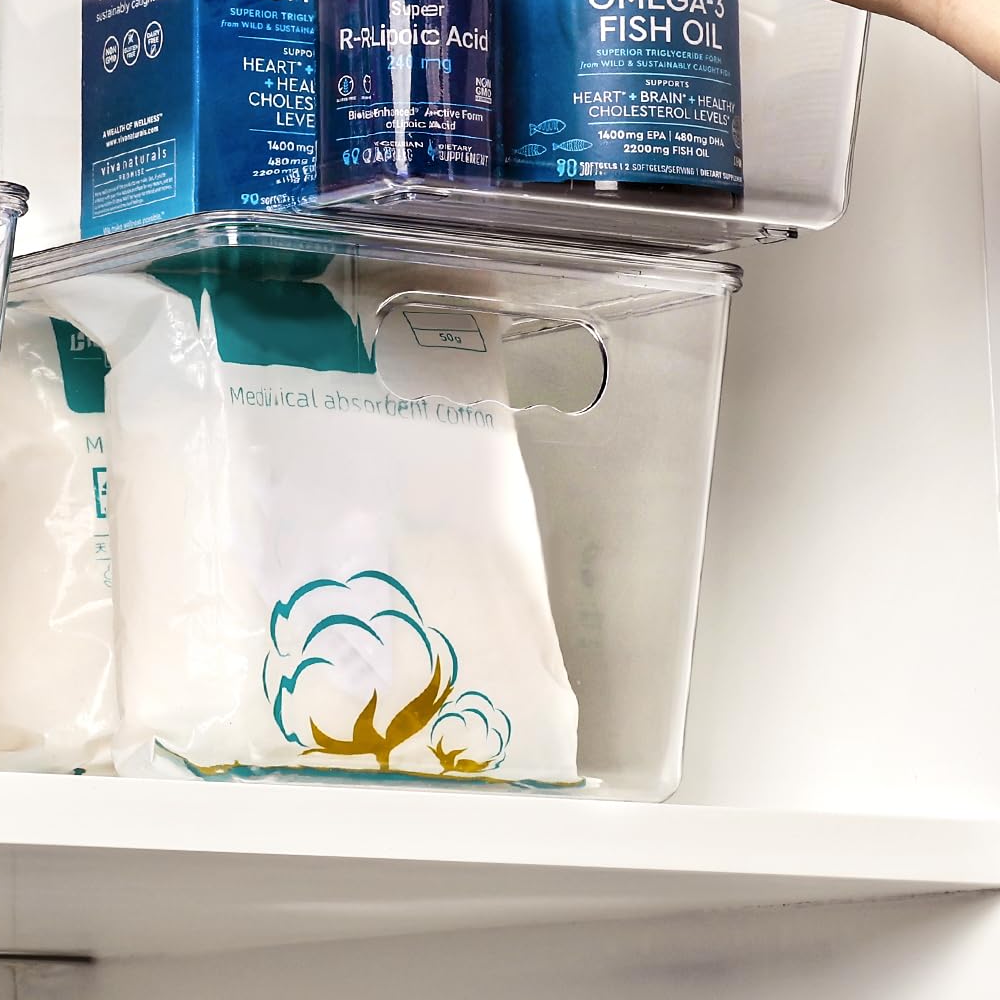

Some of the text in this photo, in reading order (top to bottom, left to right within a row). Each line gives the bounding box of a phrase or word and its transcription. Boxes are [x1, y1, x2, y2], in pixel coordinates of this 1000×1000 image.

[96, 0, 130, 23] sustainably
[230, 8, 278, 20] SUPERIOR
[220, 20, 239, 28] from
[242, 21, 264, 30] WILD
[446, 24, 489, 51] Acid
[600, 16, 722, 50] FISH OIL
[596, 48, 722, 64] SUPERIOR TRIGLYCERIDE FORM
[580, 60, 598, 70] from
[600, 60, 624, 68] WILD
[636, 60, 691, 70] SUSTAINABLY
[692, 64, 718, 75] CAUGHT
[476, 77, 492, 88] NON
[646, 79, 690, 88] SUPPORTS
[249, 92, 314, 110] CHOLES
[698, 95, 736, 113] HEALTHY
[276, 112, 315, 128] LEVE
[462, 110, 484, 122] Form
[589, 105, 691, 120] CHOLESTEROL
[598, 130, 724, 148] 1400mg EPA 480mg DHA
[438, 144, 472, 152] DIETARY
[623, 144, 710, 158] 2200mg FISH OIL
[101, 147, 167, 176] vivanaturals
[439, 332, 462, 344] 50g
